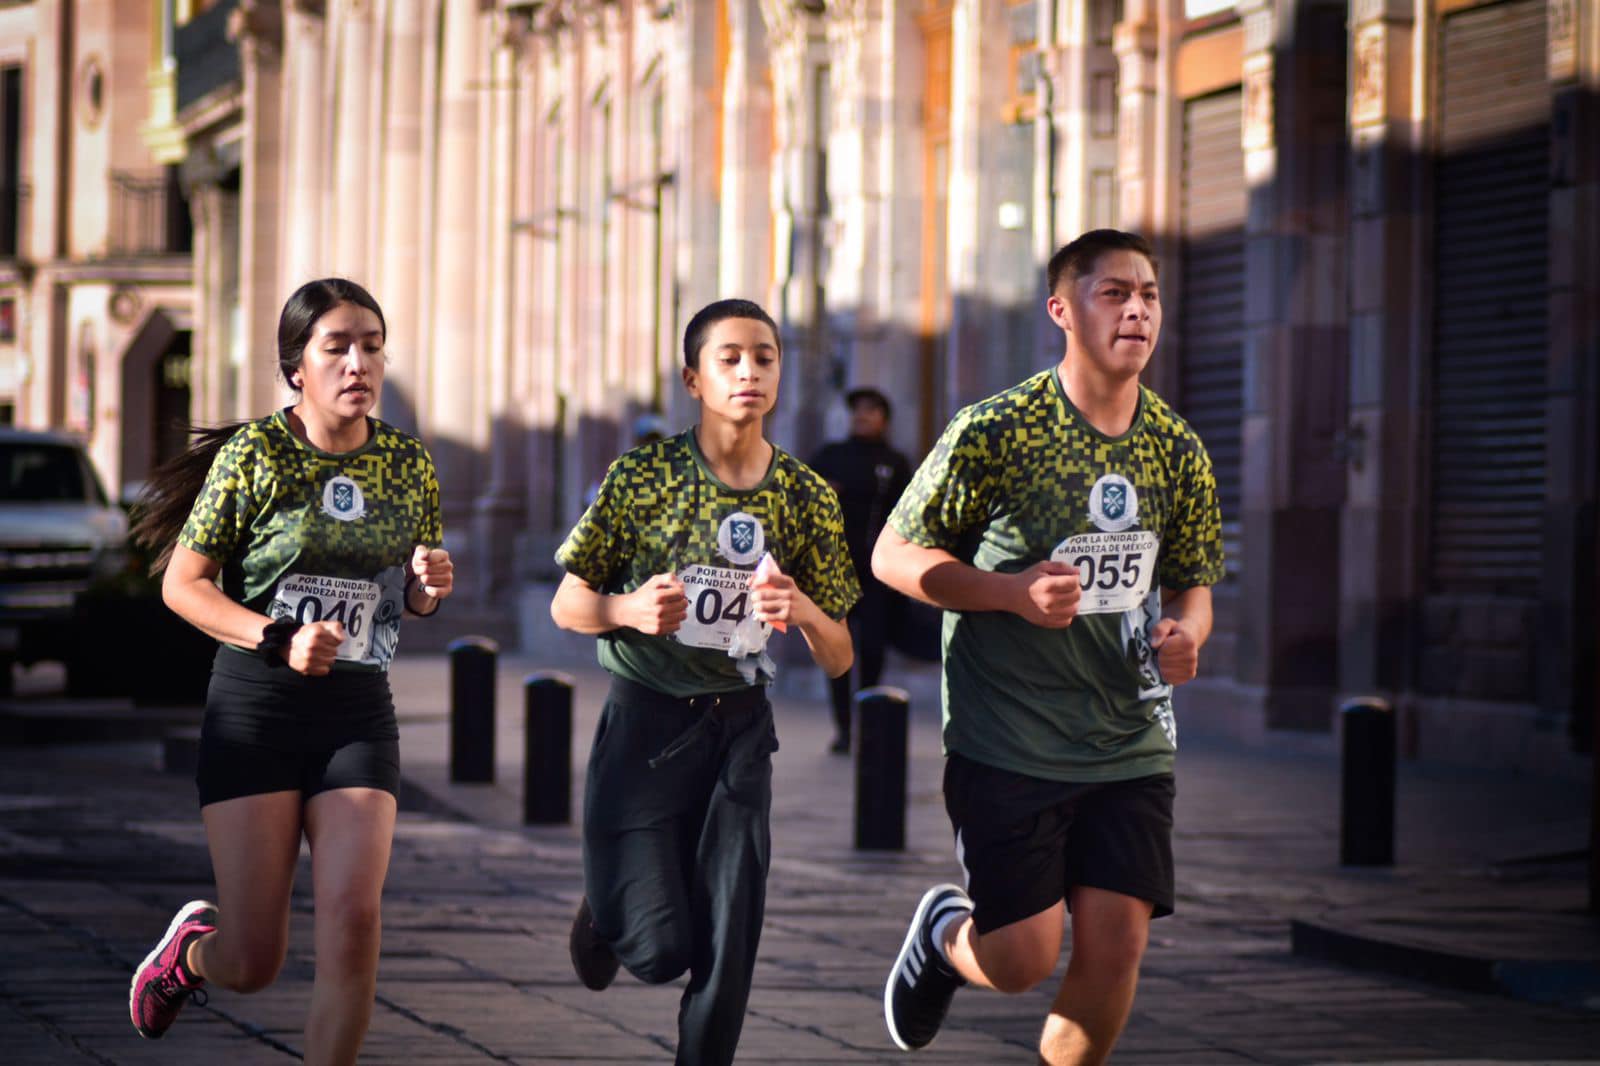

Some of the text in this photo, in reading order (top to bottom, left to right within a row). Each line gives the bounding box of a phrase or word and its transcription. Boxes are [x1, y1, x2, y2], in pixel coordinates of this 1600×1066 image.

[1071, 533, 1146, 544] POR LA UNIDAD Y
[1058, 545, 1107, 554] GRANDEZA
[1108, 544, 1119, 552] DE
[697, 568, 717, 577] POR
[720, 570, 732, 579] LA
[1073, 554, 1142, 591] 055
[299, 577, 318, 585] POR
[320, 577, 333, 587] LA
[683, 575, 736, 590] GRANDEZA
[284, 583, 336, 598] GRANDEZA
[338, 590, 350, 599] DE
